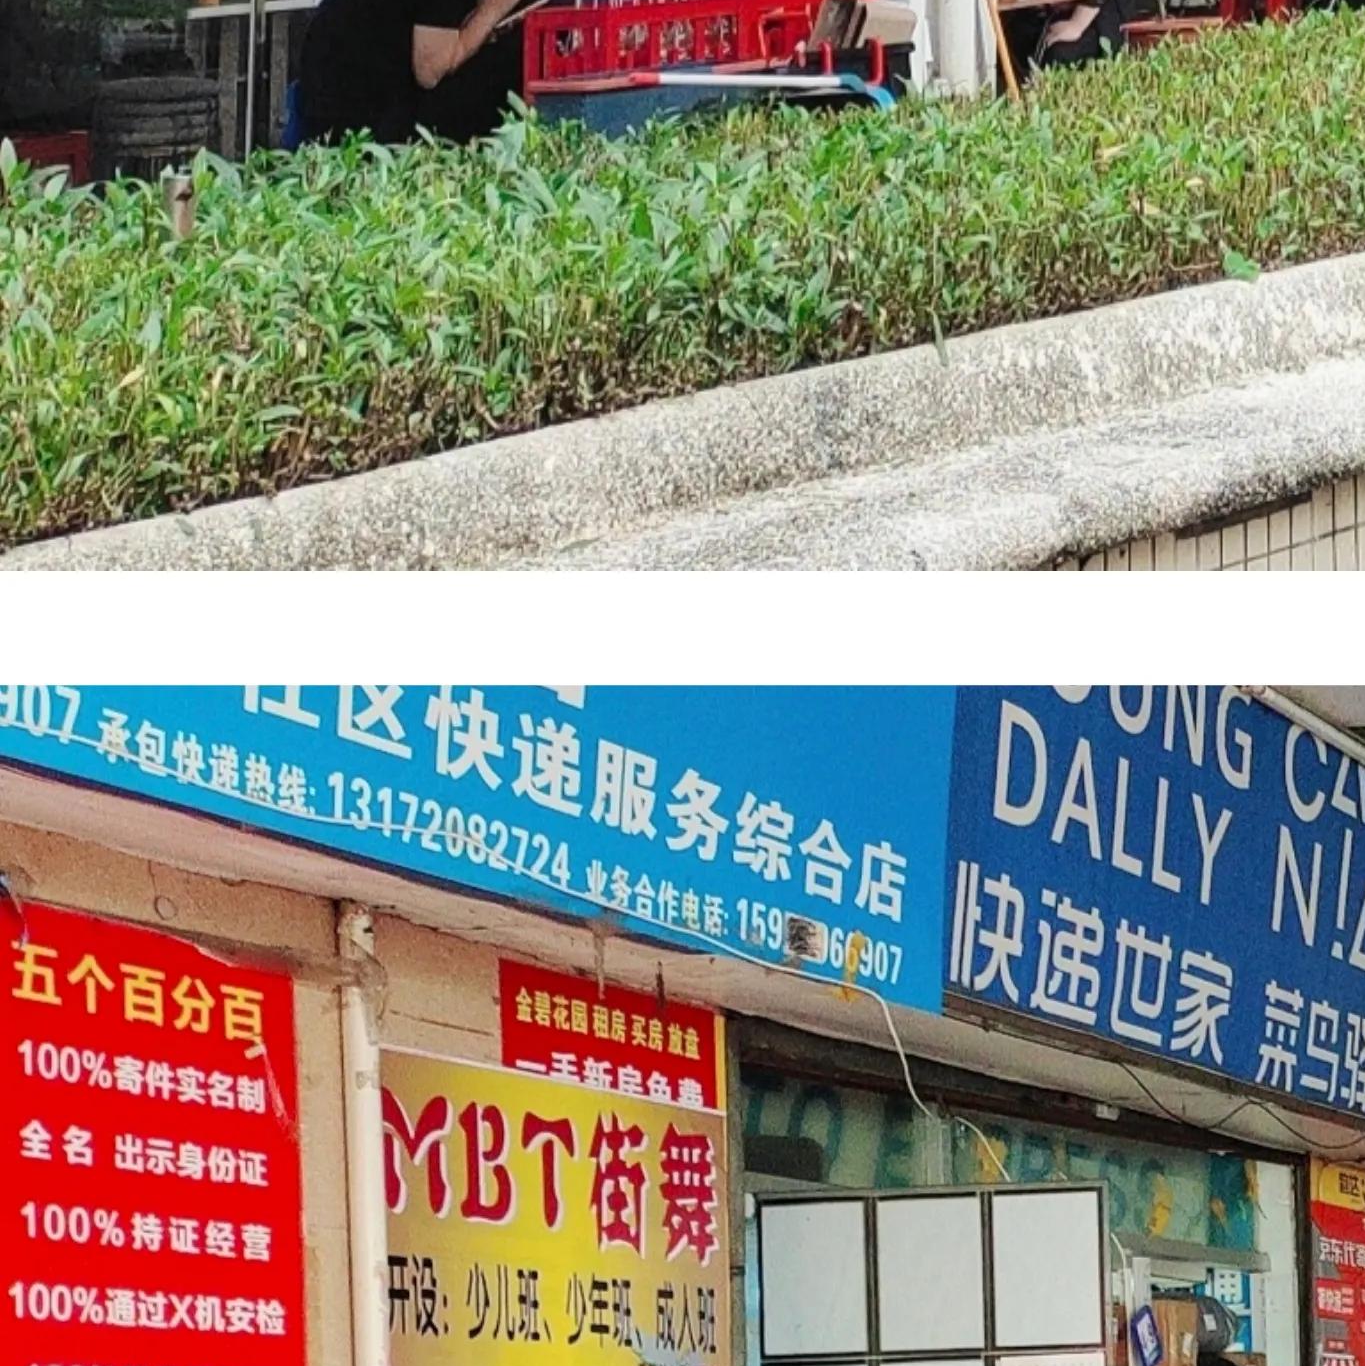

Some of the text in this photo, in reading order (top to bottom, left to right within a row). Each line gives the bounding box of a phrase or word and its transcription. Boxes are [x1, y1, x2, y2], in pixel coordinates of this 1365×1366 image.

[326, 770, 573, 890] 13172082724
[992, 697, 1234, 906] DALLY
[10, 939, 264, 1042] 五个百分百
[949, 860, 1235, 1067] 快递世家
[515, 986, 589, 1036] 金碧花园
[592, 1004, 627, 1044] 租房
[631, 1014, 664, 1053] 买房
[17, 1038, 267, 1115] 100%寄件实名制
[19, 1119, 268, 1187] 全名 出示身份证
[20, 1201, 273, 1262] 100%持证经营
[8, 1281, 286, 1337] 100%通过X机安检
